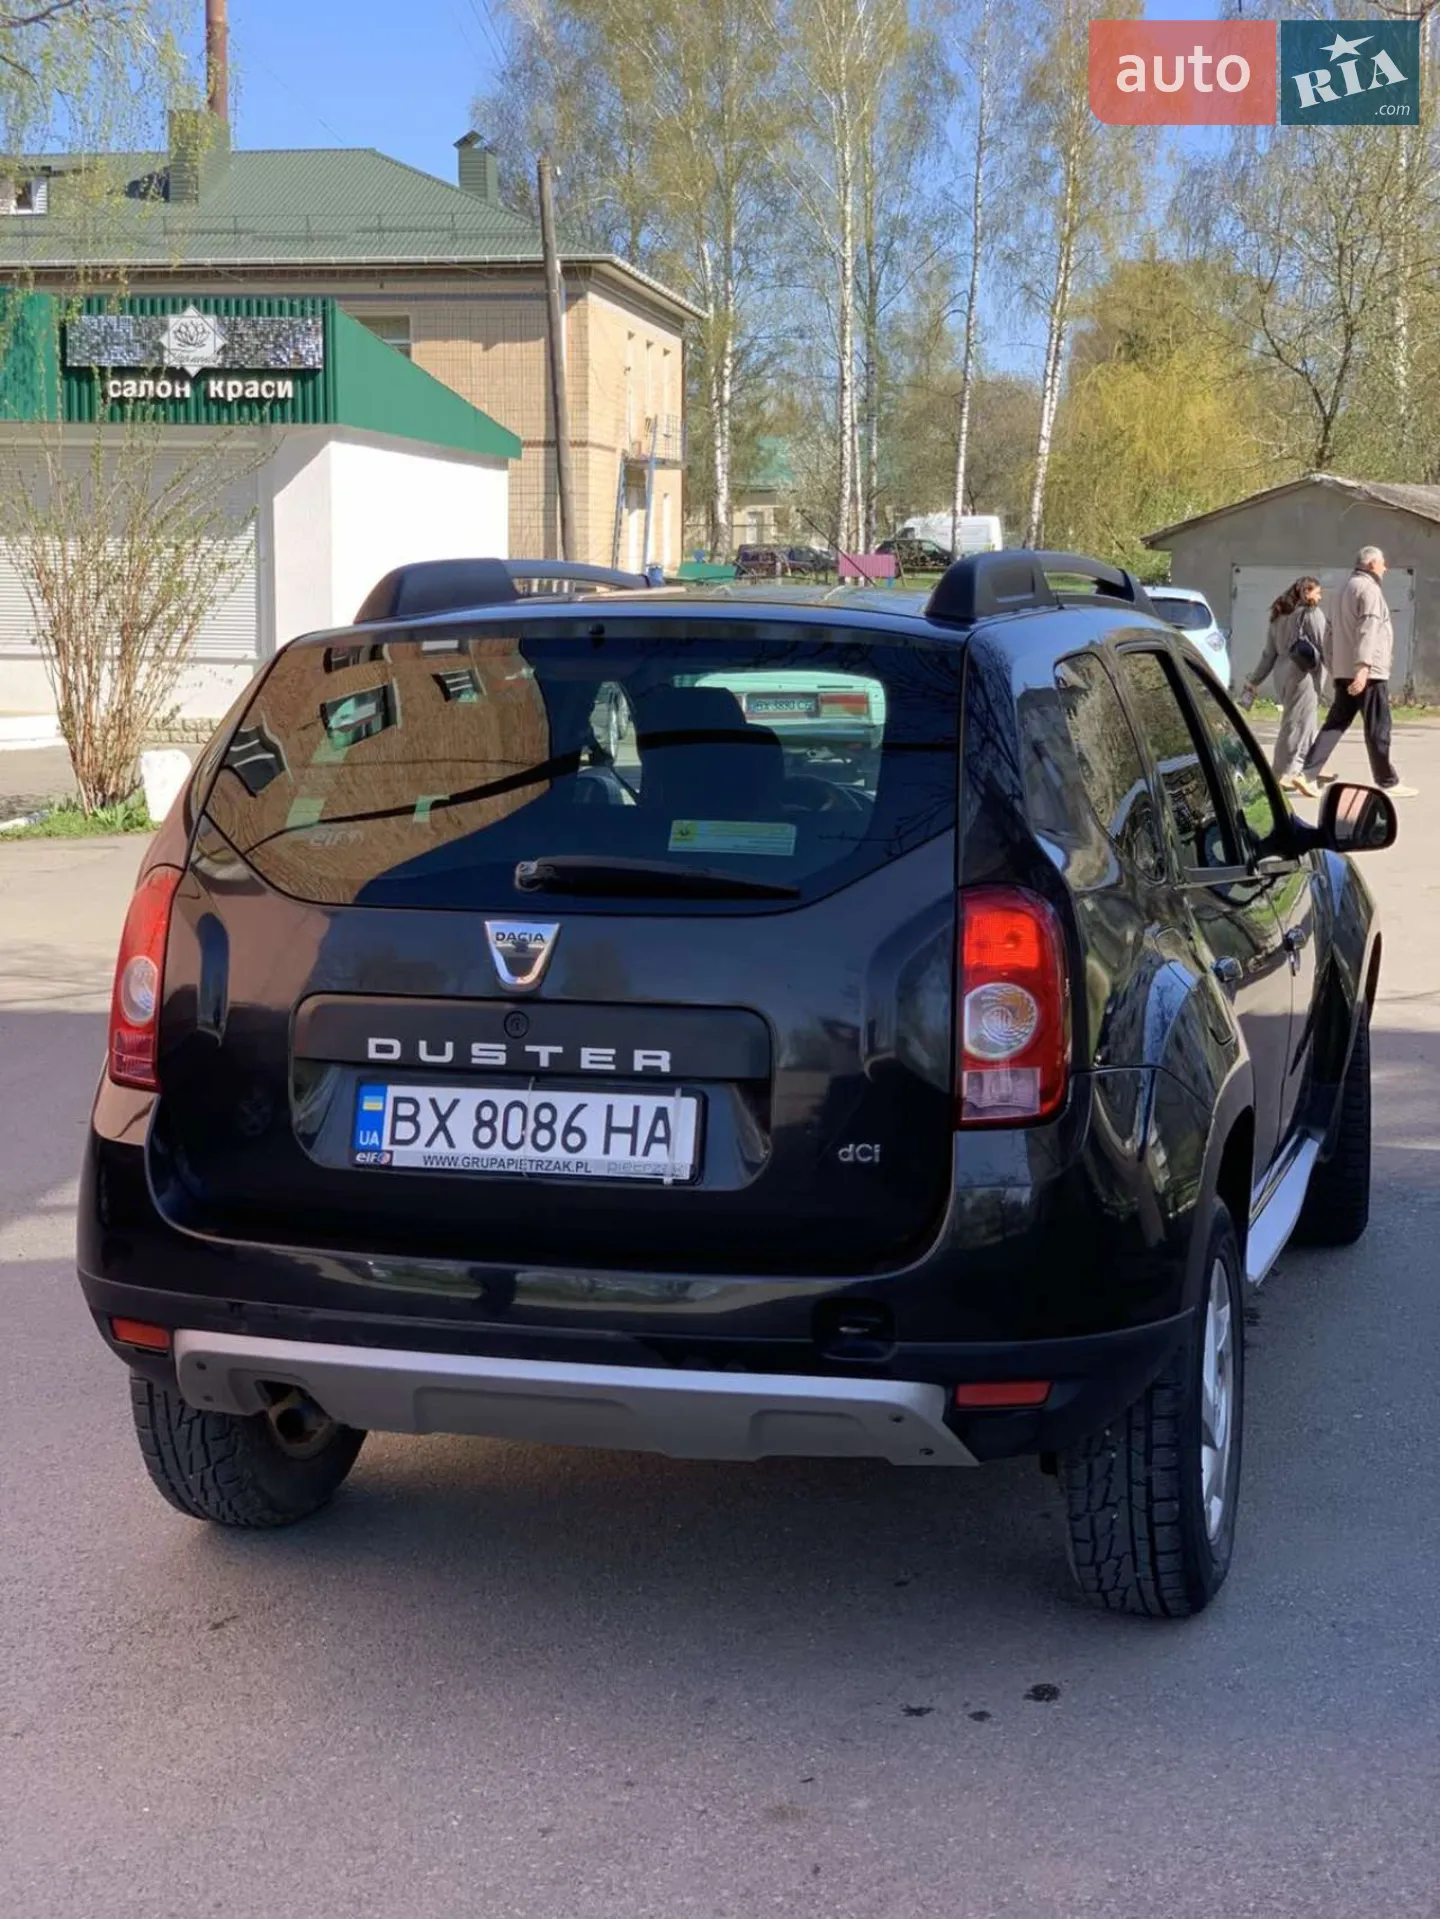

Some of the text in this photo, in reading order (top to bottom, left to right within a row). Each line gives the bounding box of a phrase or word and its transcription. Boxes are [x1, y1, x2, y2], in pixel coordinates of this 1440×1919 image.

[108, 379, 294, 401] салон краси
[495, 931, 545, 943] DACIA
[368, 1037, 671, 1073] DUSTER
[389, 1096, 673, 1157] BX 8086 HA
[359, 1130, 380, 1146] UA
[838, 1143, 881, 1162] dCi
[422, 1154, 592, 1174] WWW.GRUPAPIETRZAK.PL
